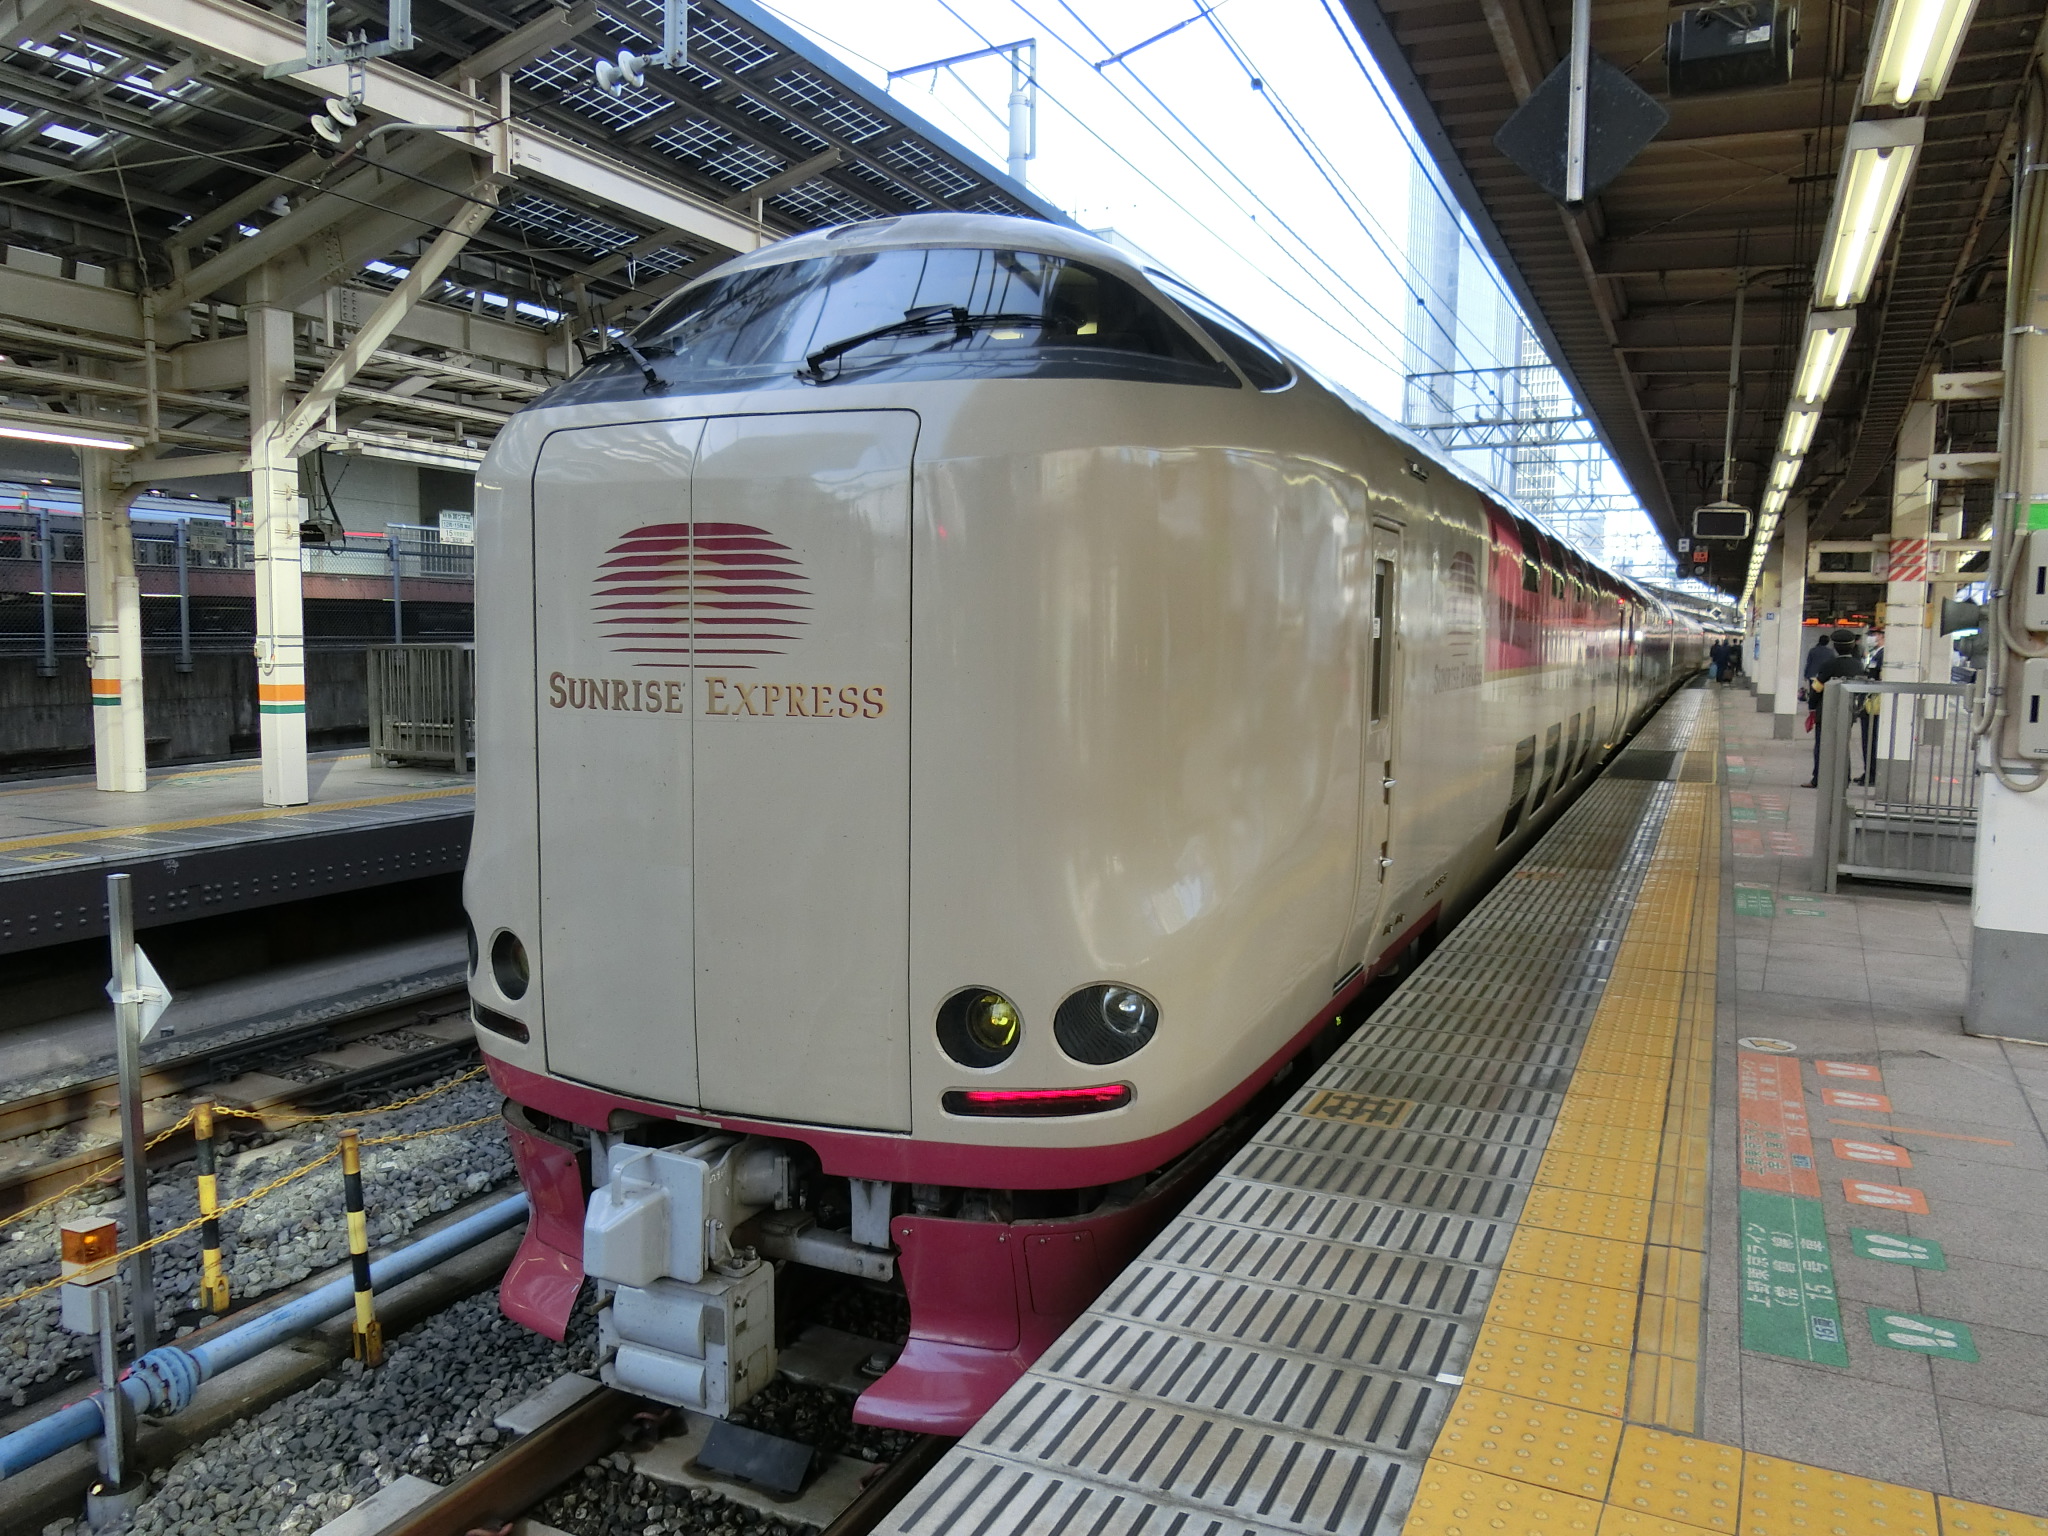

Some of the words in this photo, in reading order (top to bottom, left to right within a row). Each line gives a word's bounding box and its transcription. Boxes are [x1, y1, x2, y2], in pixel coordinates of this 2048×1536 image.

[549, 671, 684, 713] SUNRISE
[704, 676, 887, 719] EXPRESS
[1745, 1222, 1771, 1308] 上野東京ライン
